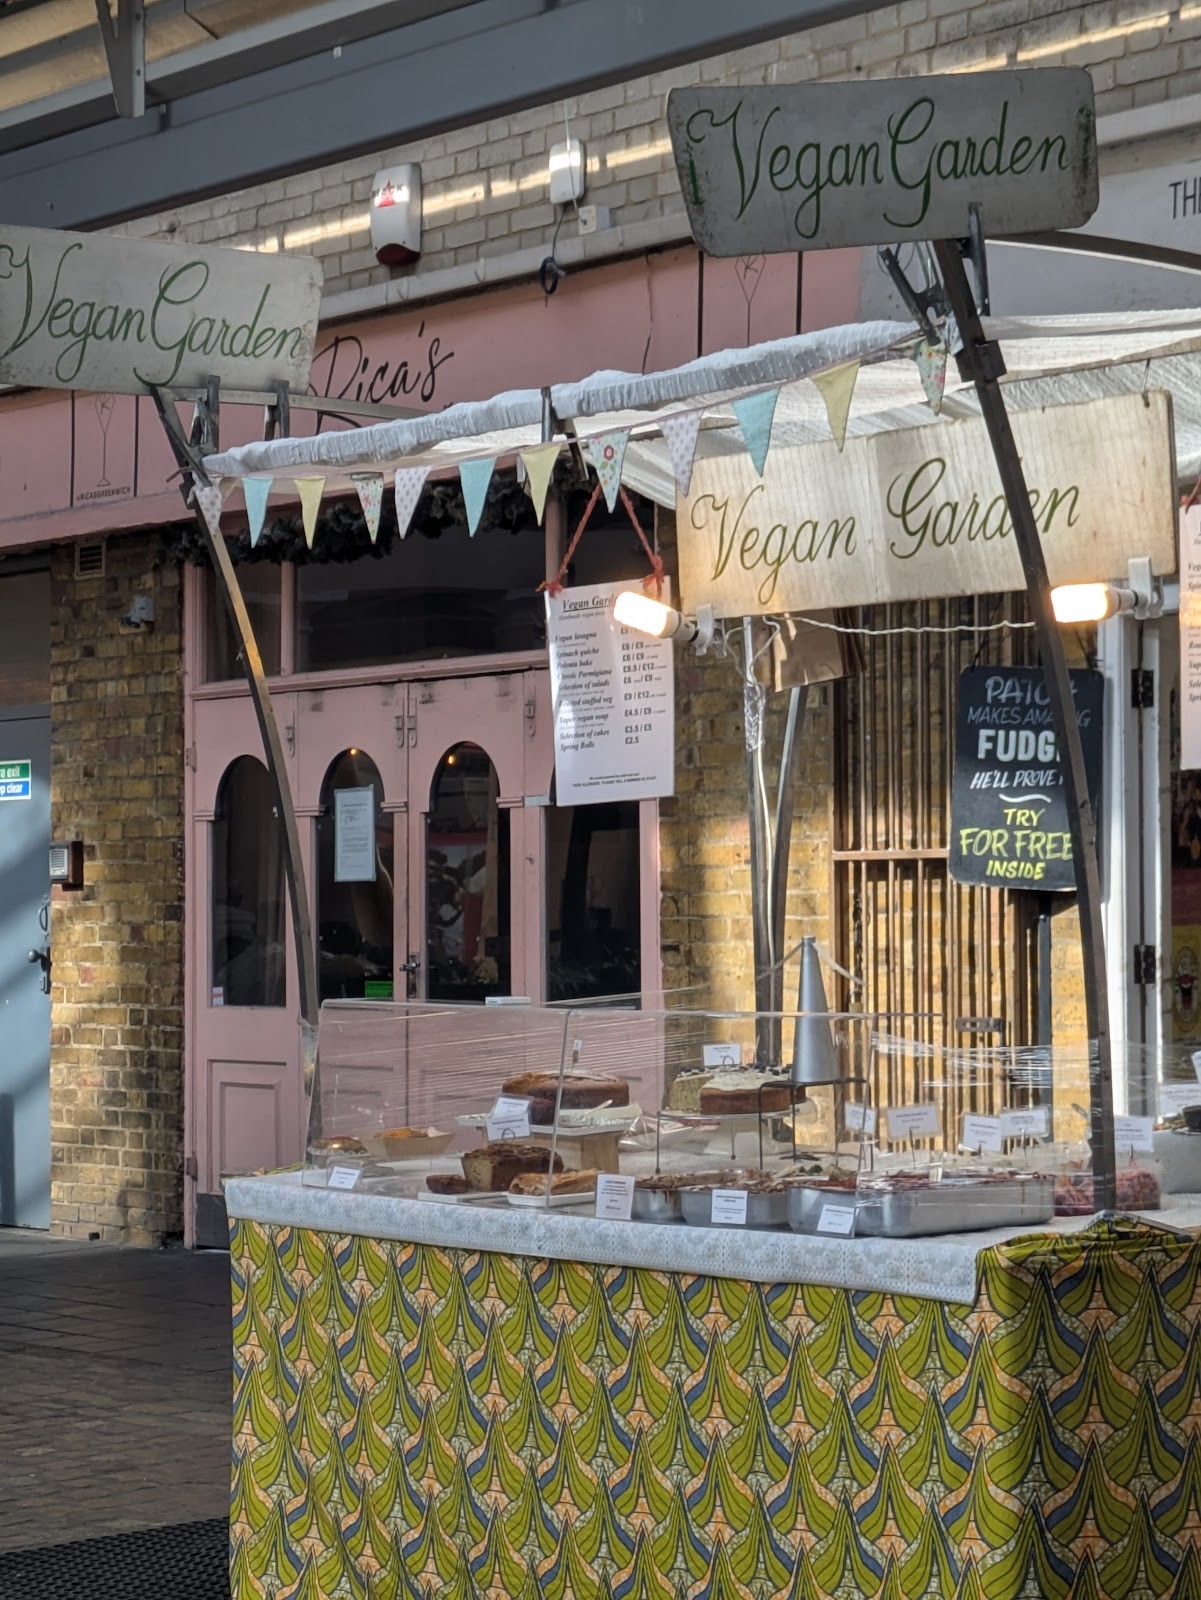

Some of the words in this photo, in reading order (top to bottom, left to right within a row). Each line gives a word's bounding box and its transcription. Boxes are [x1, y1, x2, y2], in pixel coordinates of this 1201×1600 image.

[686, 100, 883, 239] Vegan
[883, 97, 1069, 228] Garden
[1168, 177, 1201, 219] TH
[0, 243, 146, 382] Vegan
[133, 261, 302, 387] Garden
[690, 484, 857, 605] Vegan
[563, 599, 589, 610] Vegan
[555, 634, 573, 642] Vegan
[574, 632, 597, 640] lasagna
[580, 647, 599, 657] quiche
[591, 679, 609, 687] salads
[967, 706, 1021, 724] MAKES
[593, 728, 609, 736] cakes
[560, 744, 579, 752] Spring
[580, 741, 595, 749] Rolls
[977, 729, 1061, 762] FUDG
[7, 765, 20, 778] exit
[970, 770, 1010, 789] HE'LL
[1012, 769, 1057, 787] PROVE
[7, 783, 23, 793] clear
[1003, 808, 1045, 827] TRY
[960, 827, 1008, 857] FOR
[1013, 830, 1073, 860] FREE
[985, 860, 1045, 880] INSIDE
